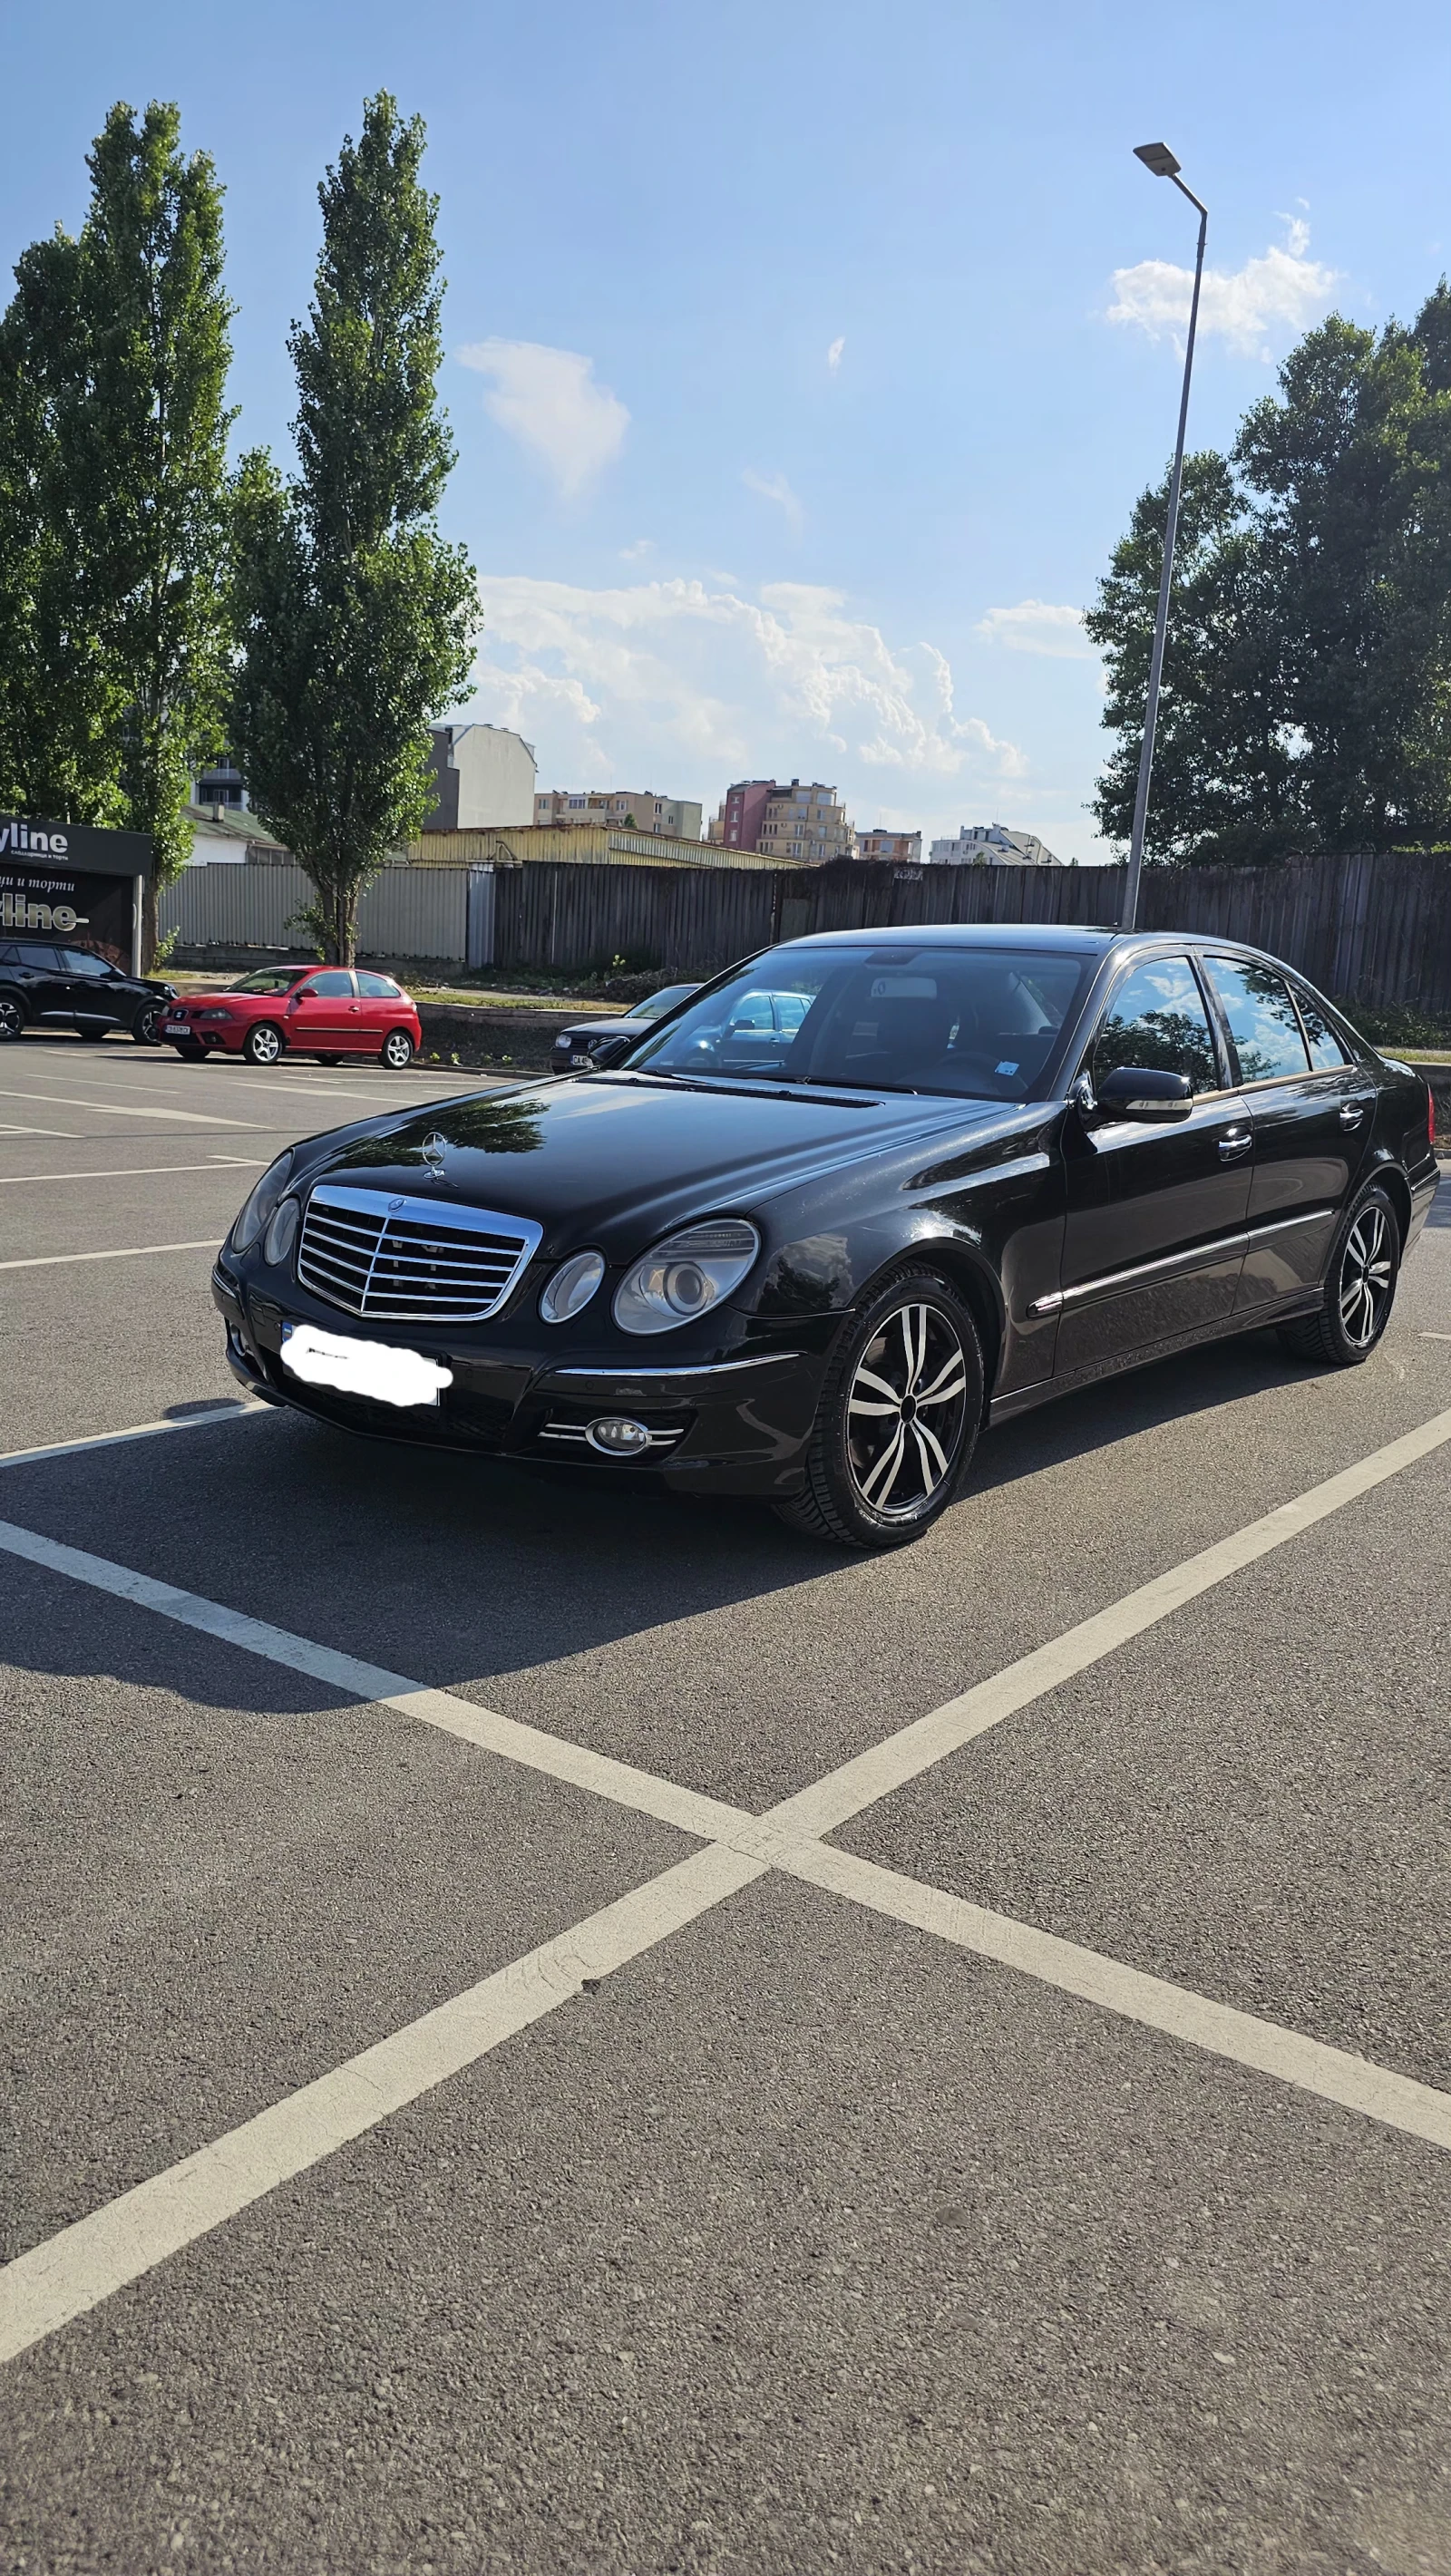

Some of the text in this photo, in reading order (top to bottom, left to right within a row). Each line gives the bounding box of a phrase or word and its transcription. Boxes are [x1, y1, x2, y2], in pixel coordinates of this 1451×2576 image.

[17, 878, 25, 887] и
[28, 879, 75, 893] торти
[0, 892, 78, 932] line
